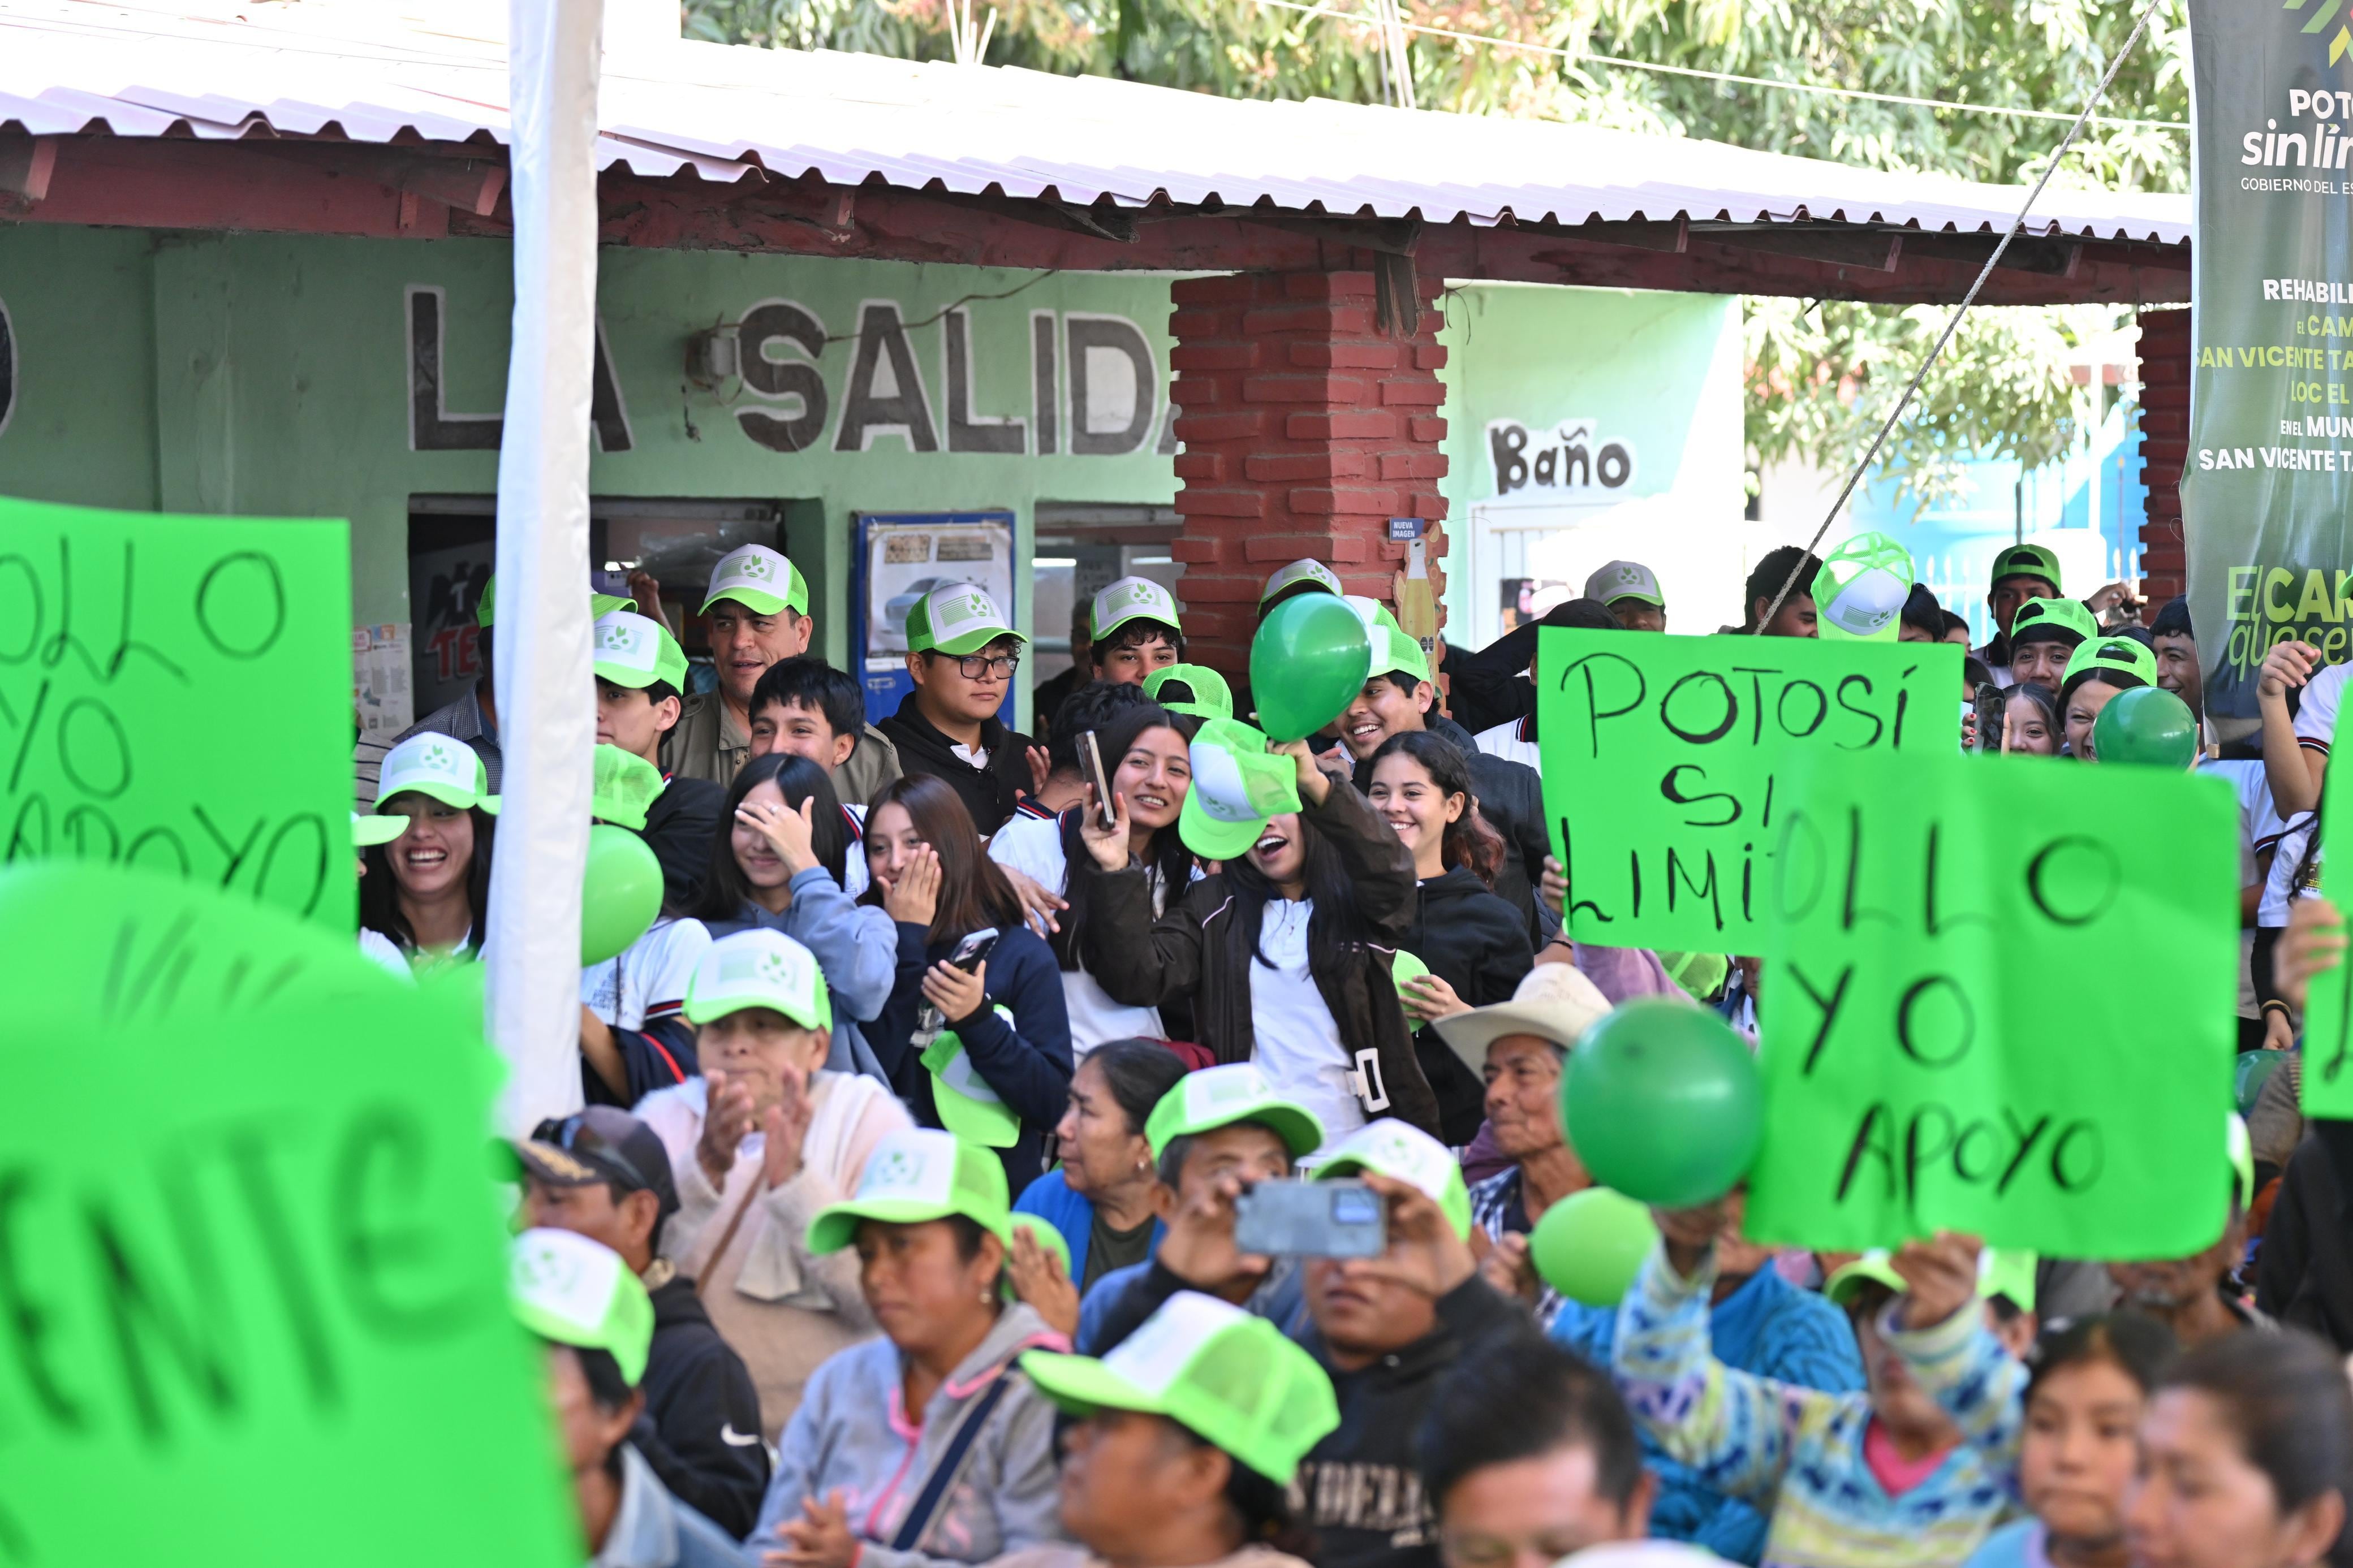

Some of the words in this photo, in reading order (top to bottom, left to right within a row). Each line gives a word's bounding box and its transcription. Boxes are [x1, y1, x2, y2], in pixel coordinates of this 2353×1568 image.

[2290, 89, 2353, 119] POT
[2241, 118, 2307, 166] sin
[2241, 177, 2312, 191] GOBIERNO
[2314, 180, 2338, 194] DEL
[2297, 321, 2305, 335] EL
[734, 298, 1180, 456] SALID
[2196, 346, 2234, 368] AN
[2238, 345, 2324, 370] VICENTE
[2291, 380, 2322, 403] LOC
[2327, 383, 2350, 404] EL
[2281, 420, 2291, 435] EN
[2292, 421, 2303, 436] EL
[1490, 425, 1631, 496] Baño
[2199, 447, 2255, 470] SAN
[2259, 447, 2336, 472] VICENTE
[2339, 451, 2353, 472] T
[1561, 653, 1917, 758] POTOSÍ
[1772, 803, 2124, 939] OLLO
[1783, 958, 1976, 1078] YO
[1834, 1100, 2105, 1221] APOYO
